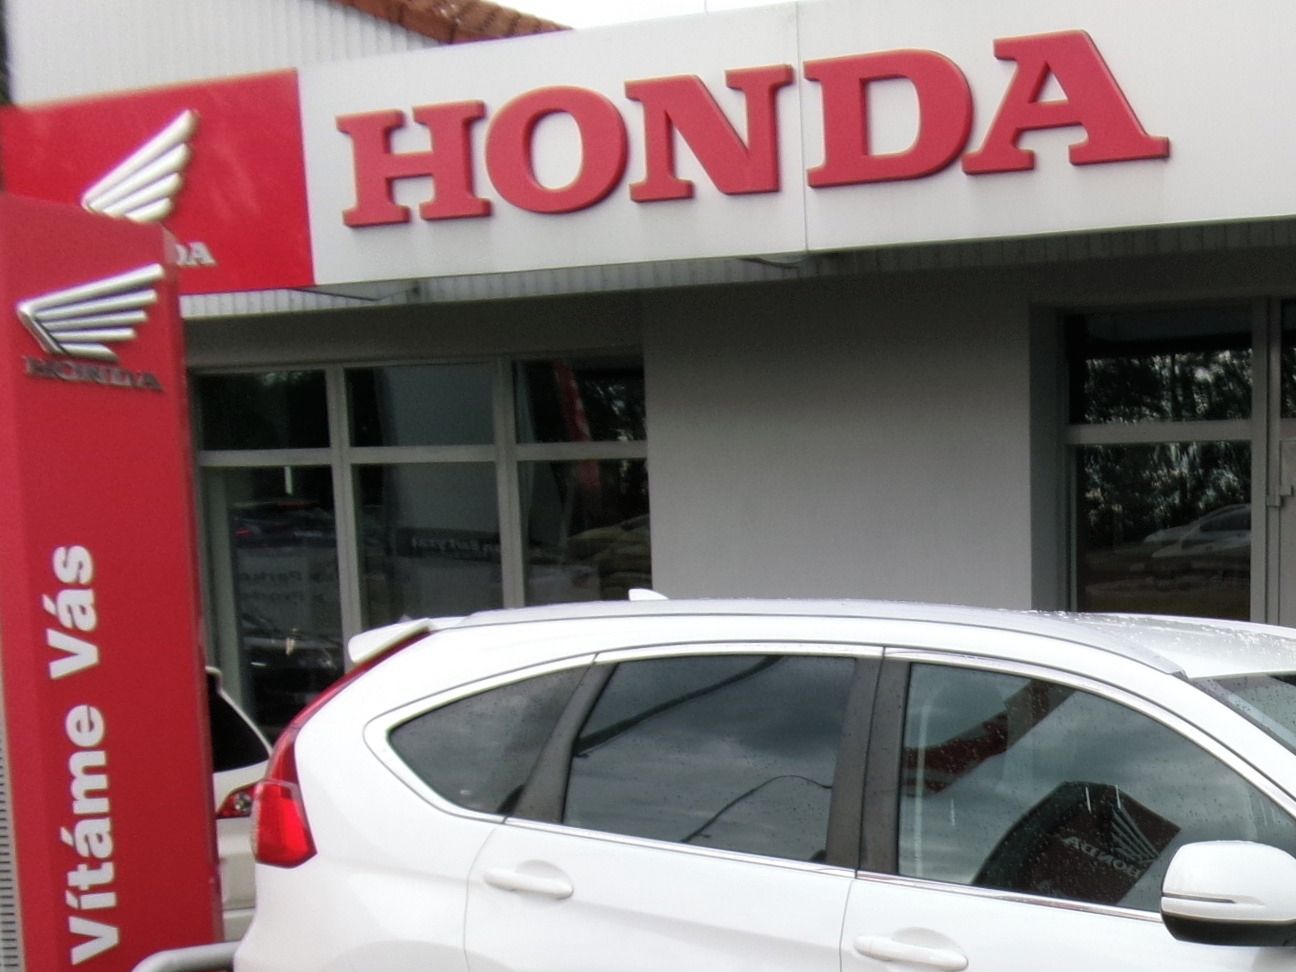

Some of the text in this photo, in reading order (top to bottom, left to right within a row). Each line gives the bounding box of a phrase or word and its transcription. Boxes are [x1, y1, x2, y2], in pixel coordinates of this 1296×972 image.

[336, 29, 1170, 229] HONDA
[22, 356, 166, 393] HONDA
[42, 544, 120, 966] Vítáme Vás
